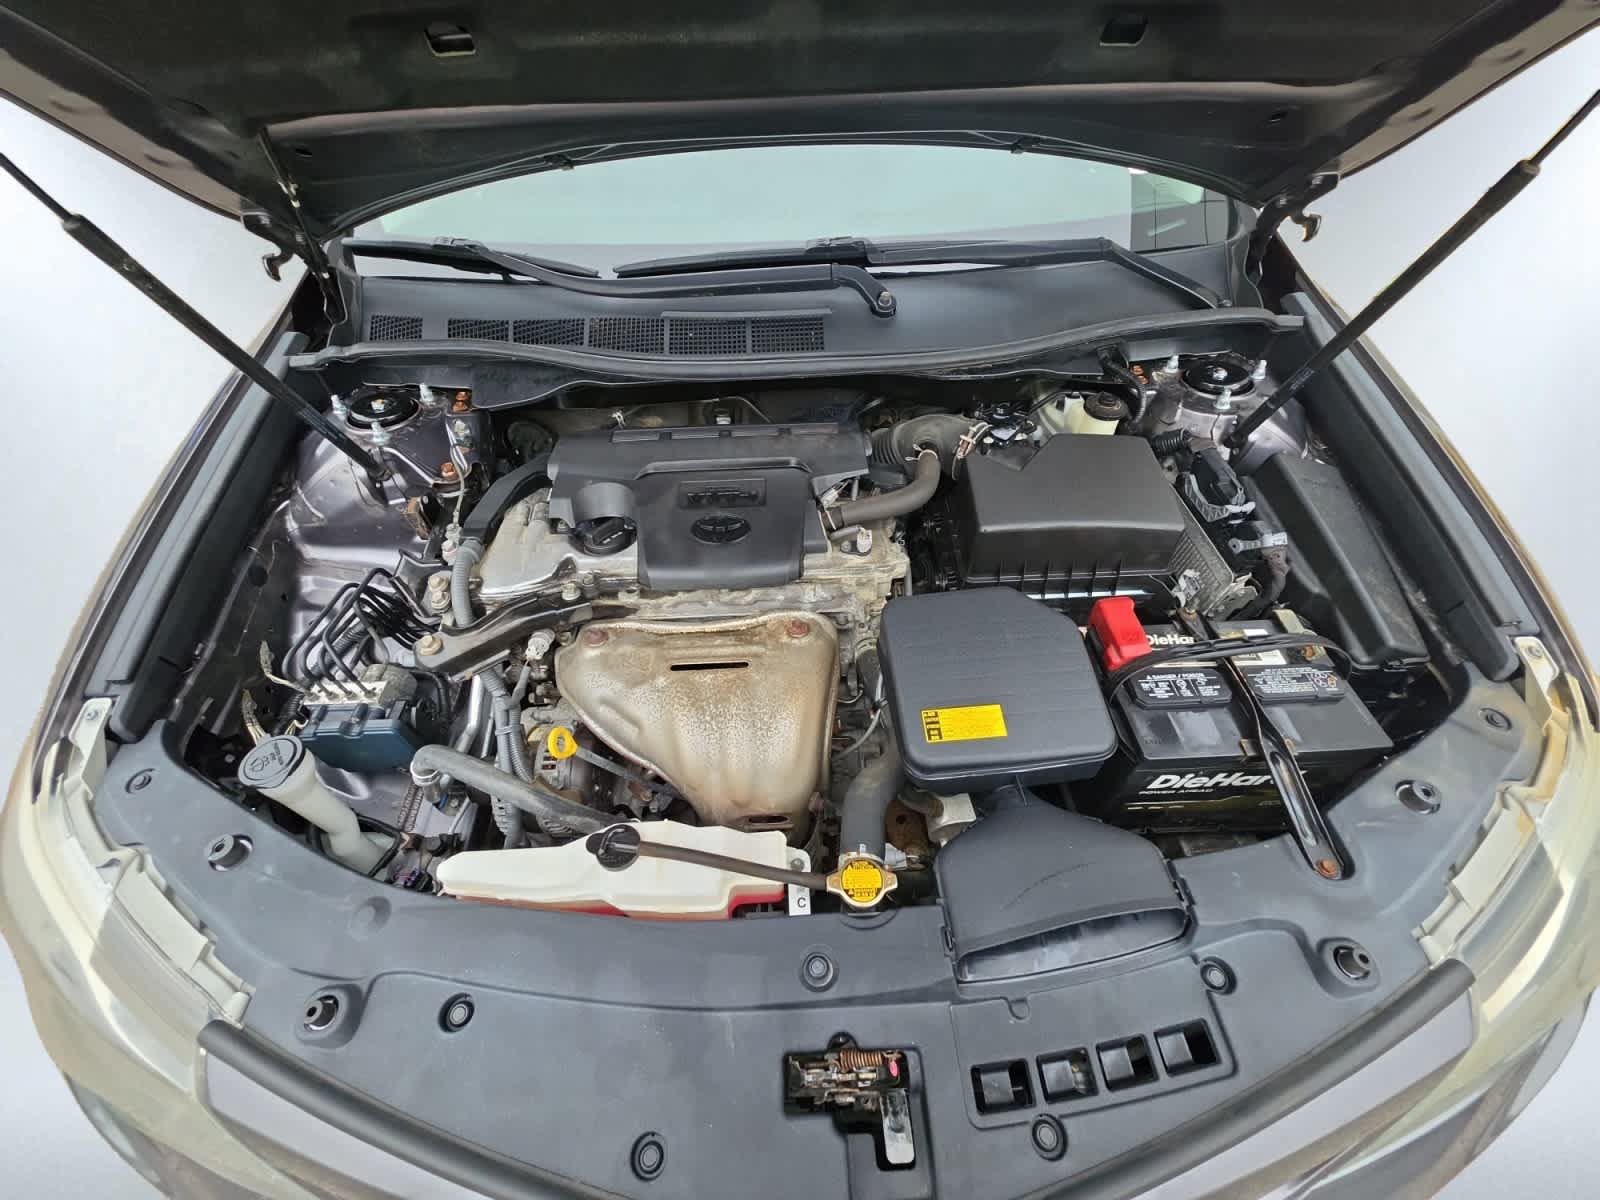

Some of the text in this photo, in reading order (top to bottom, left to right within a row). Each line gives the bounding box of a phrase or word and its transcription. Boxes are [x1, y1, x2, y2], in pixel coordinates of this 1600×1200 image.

[1145, 633, 1195, 645] DieHar
[1147, 771, 1308, 789] DieHar
[797, 896, 807, 908] C
